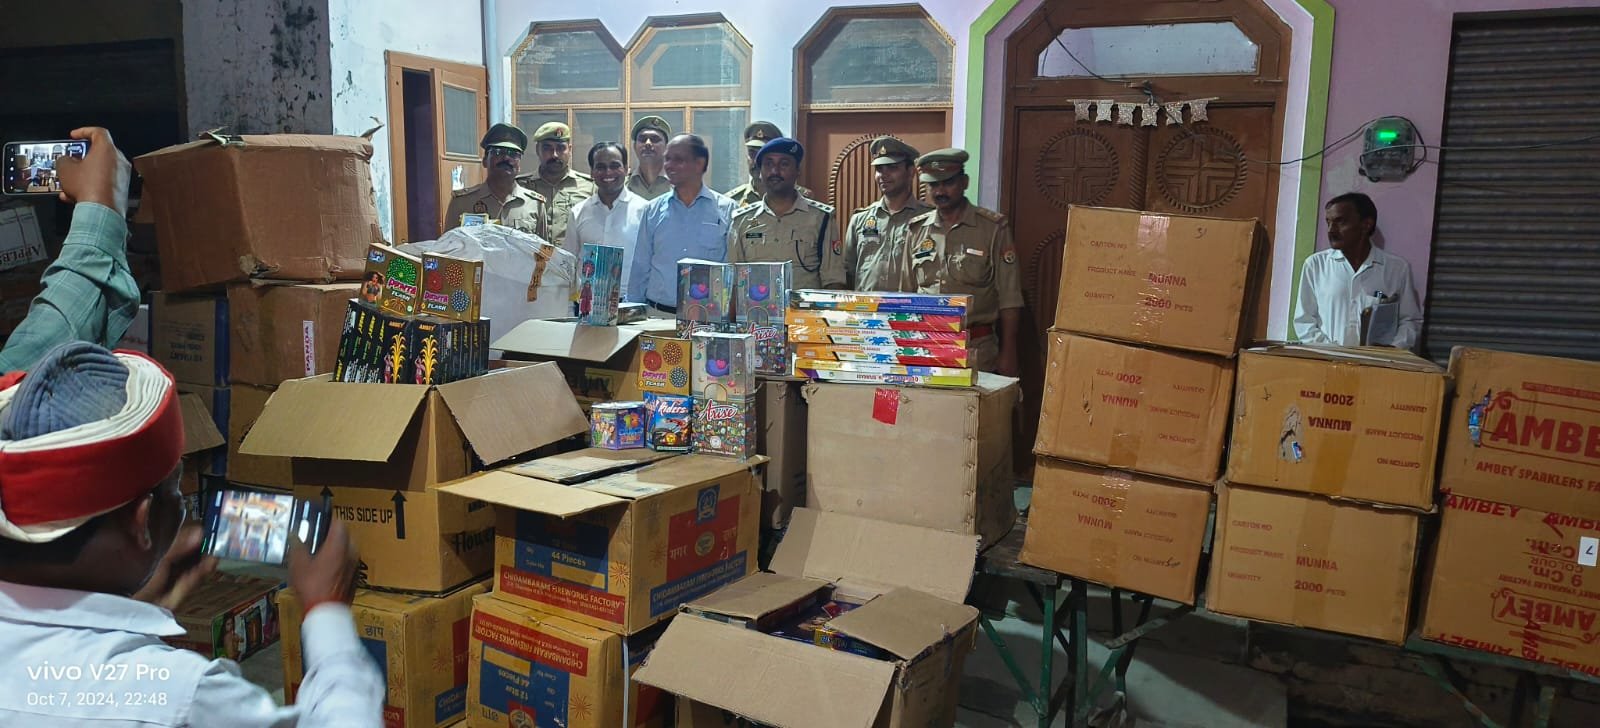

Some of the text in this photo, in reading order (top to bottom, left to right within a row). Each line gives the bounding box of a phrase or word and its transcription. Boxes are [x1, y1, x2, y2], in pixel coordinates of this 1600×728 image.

[1149, 272, 1186, 287] MUNNA
[1145, 297, 1171, 309] 2000
[1116, 373, 1142, 384] 2000
[658, 398, 688, 415] Riders
[1102, 394, 1138, 408] MUNNA
[1323, 393, 1354, 406] 2000
[699, 399, 738, 421] Arise
[1390, 403, 1427, 413] QUANTITY
[1308, 415, 1352, 432] MUNNA
[1386, 430, 1424, 442] PRODUCT
[1390, 459, 1421, 469] CARTON
[1476, 461, 1516, 477] AMBEY
[1518, 468, 1583, 489] SPARKLERS
[1092, 495, 1117, 507] 2000
[1444, 495, 1521, 518] AMBEY
[334, 505, 393, 524] THIS SIDE UP
[1078, 514, 1113, 530] MUNNA
[561, 553, 587, 567] Pieces
[1296, 556, 1338, 571] MUNNA
[1531, 557, 1584, 573] COLOUR
[1528, 565, 1583, 588] 9 Cm.
[503, 573, 551, 592] CHIDAMBARAM
[550, 582, 589, 602] FIREWORKS
[590, 593, 624, 609] FACTORY
[1294, 580, 1323, 593] 2000
[1497, 595, 1597, 630] AMBEY
[500, 635, 534, 654] FIREWORKS
[533, 648, 584, 669] CHIDAMBARAM
